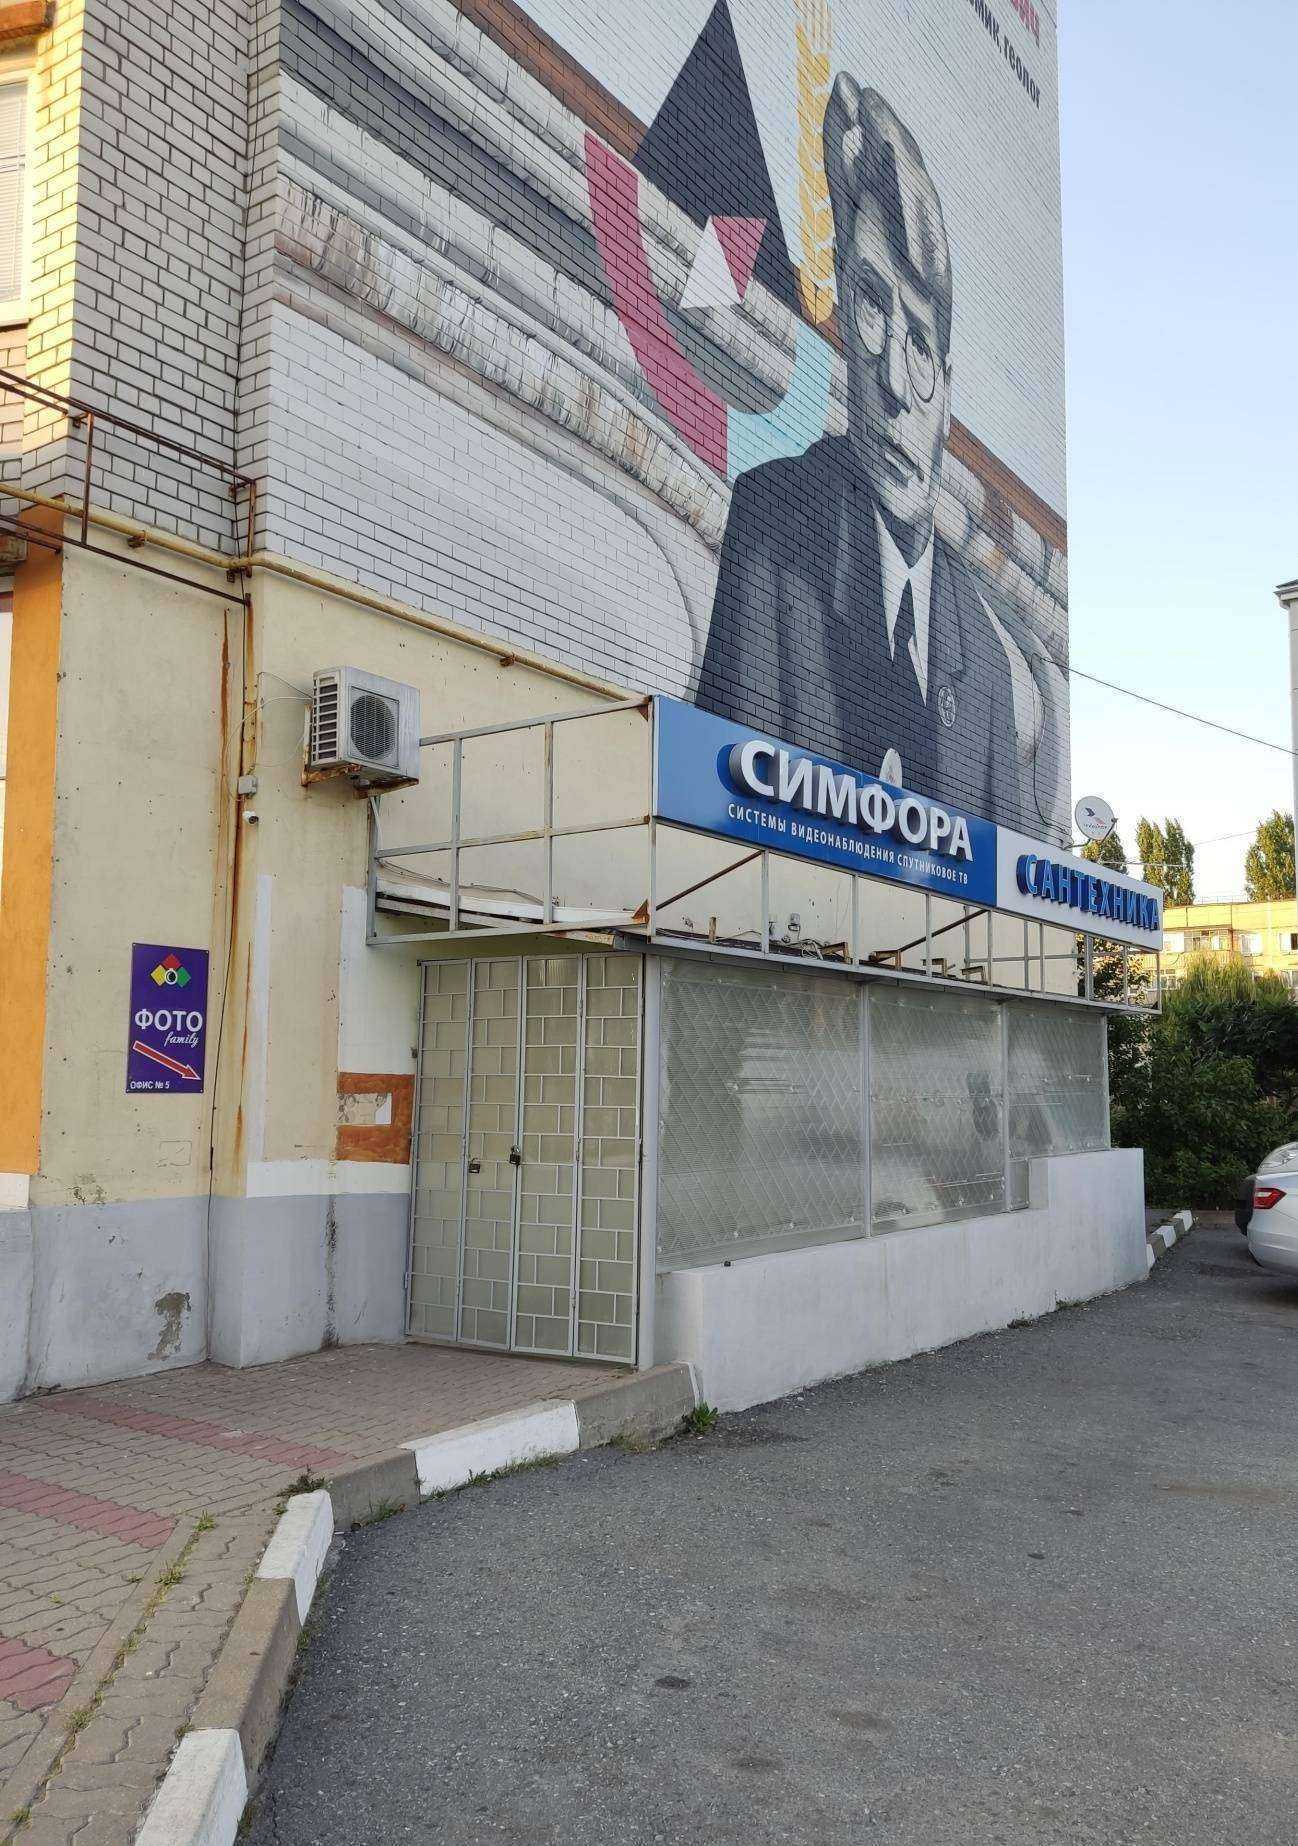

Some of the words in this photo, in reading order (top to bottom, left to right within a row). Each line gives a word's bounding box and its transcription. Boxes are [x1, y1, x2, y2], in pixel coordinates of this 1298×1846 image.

[967, 0, 1001, 53] мик,
[1004, 35, 1040, 110] геолог
[727, 740, 974, 862] СИМФОРА
[728, 803, 786, 833] СИСТЕМЫ
[791, 822, 894, 864] ВИДЕОНАБЛЮДЕНИЯ
[897, 854, 957, 882] СПУТНИКОВОЕ
[959, 871, 968, 885] ТВ
[1016, 854, 1160, 930] САНТЕХНИКА
[135, 1008, 203, 1032] ФОТО
[164, 1031, 199, 1048] family
[130, 1081, 154, 1090] ОФИС
[165, 1081, 170, 1089] 5
